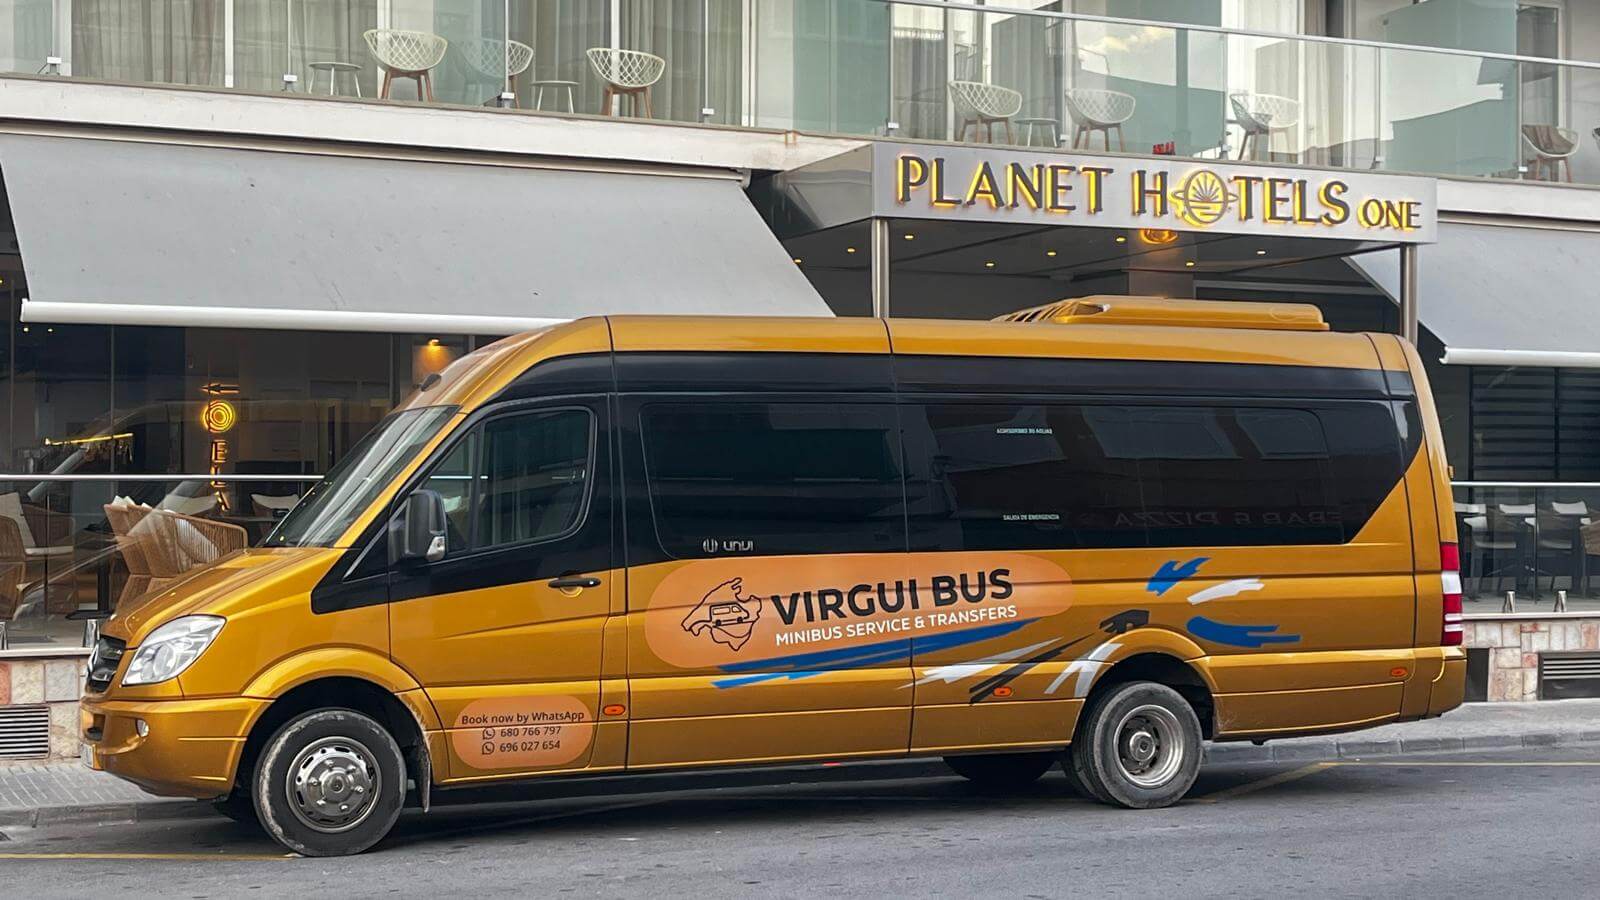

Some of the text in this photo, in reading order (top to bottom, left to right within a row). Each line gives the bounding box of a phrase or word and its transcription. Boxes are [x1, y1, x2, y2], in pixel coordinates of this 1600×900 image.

[897, 155, 1422, 231] PLANET HOTELS ONE
[771, 568, 1013, 625] VIRGUI BUS
[775, 604, 1018, 647] MINIBUS SERVICE & TRANSFERS
[461, 710, 585, 725] Book now by WhatsApp
[500, 725, 562, 738] 680 766 797
[499, 740, 561, 753] 696 027 654
